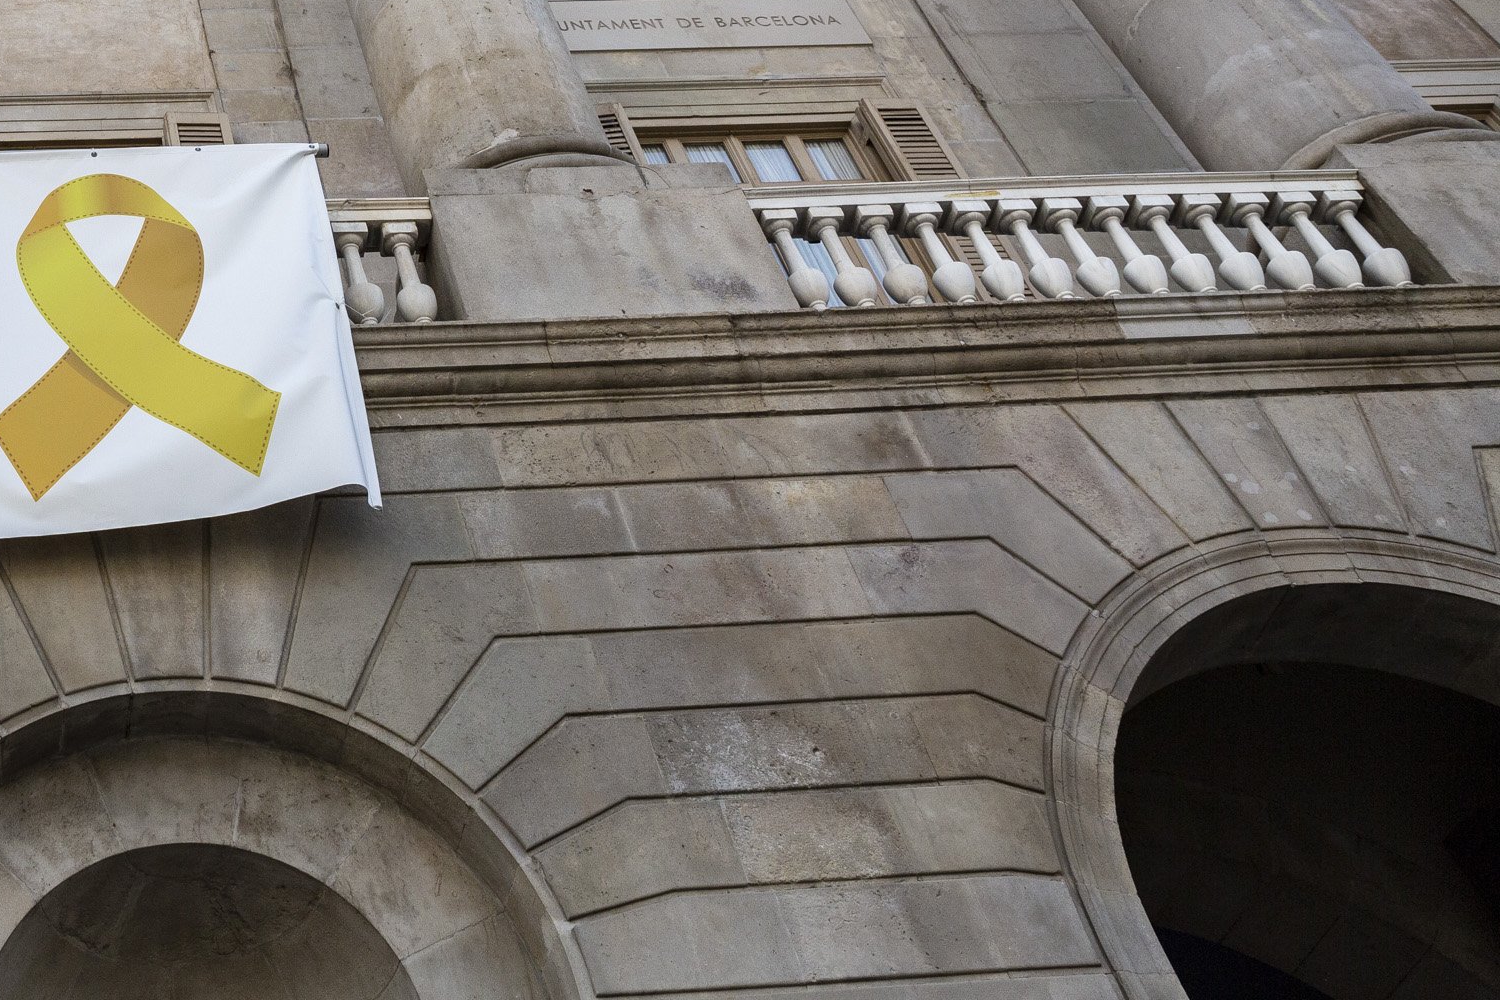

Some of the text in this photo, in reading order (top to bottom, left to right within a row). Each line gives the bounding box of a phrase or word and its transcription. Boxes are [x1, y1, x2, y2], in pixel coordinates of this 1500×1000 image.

[556, 14, 842, 32] UNTAMENT DE BARCELONA
